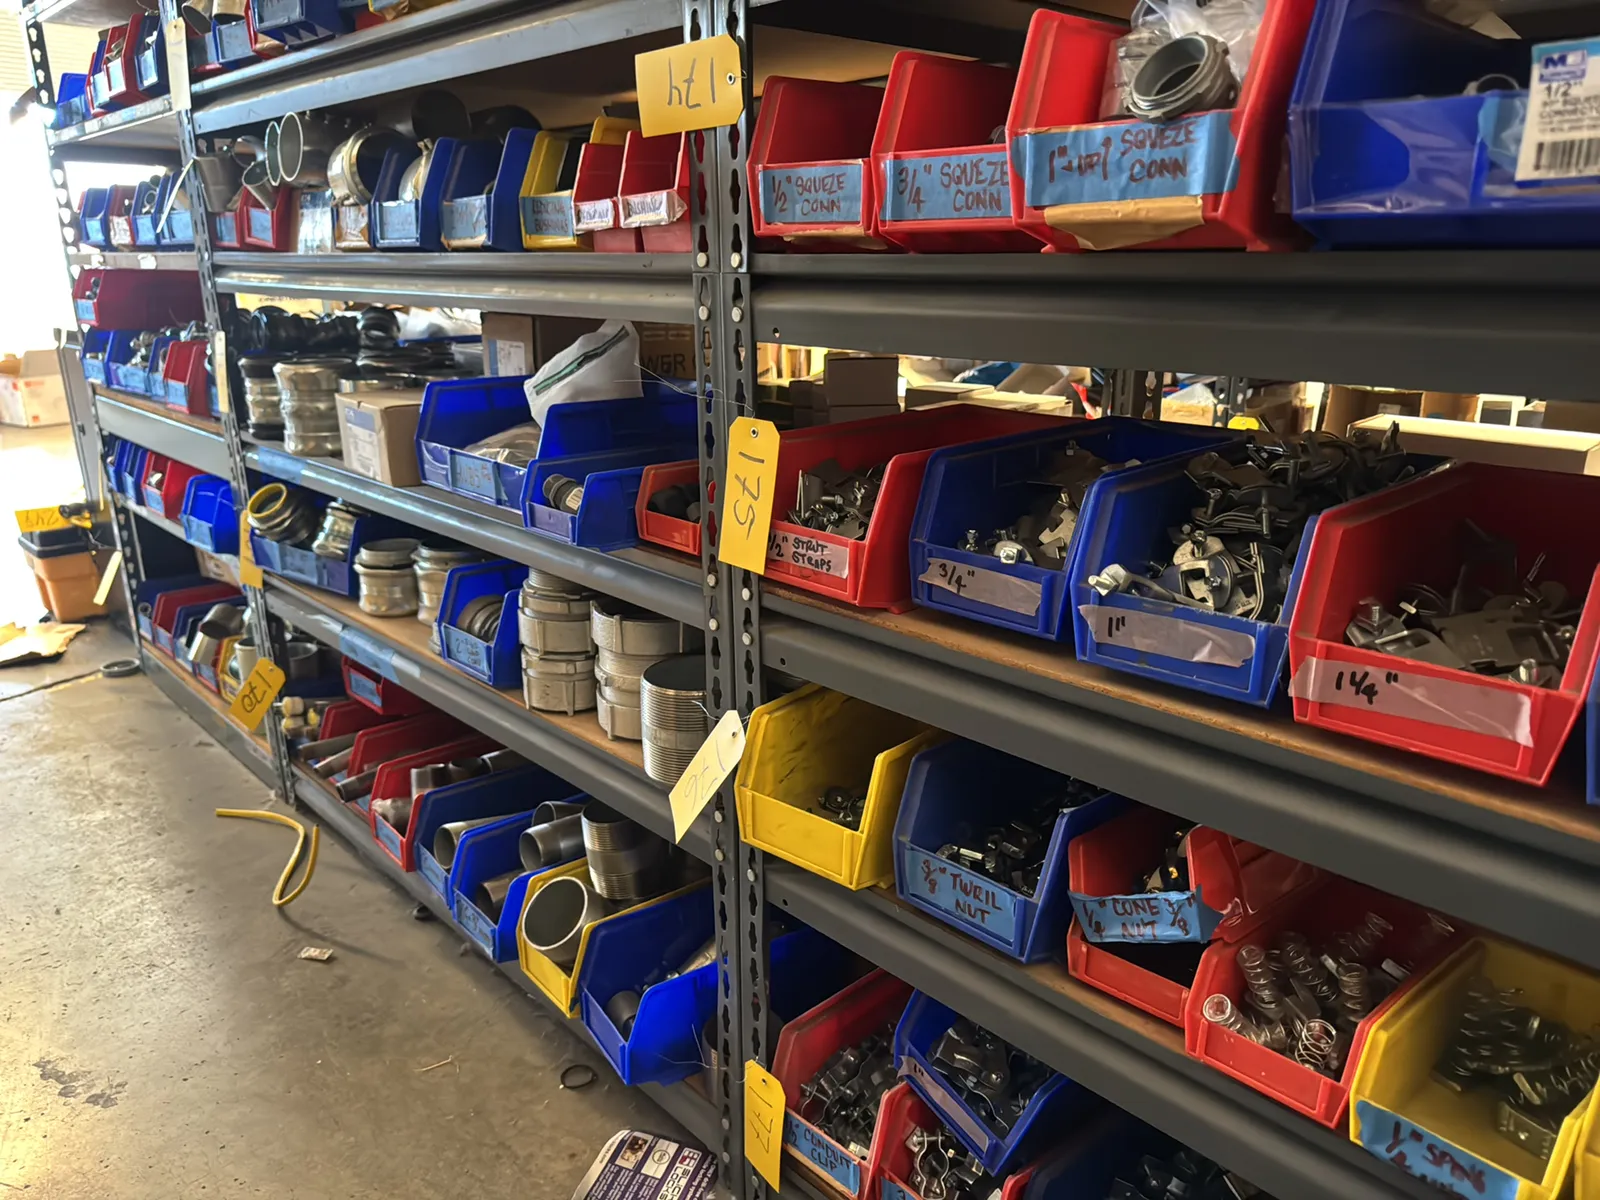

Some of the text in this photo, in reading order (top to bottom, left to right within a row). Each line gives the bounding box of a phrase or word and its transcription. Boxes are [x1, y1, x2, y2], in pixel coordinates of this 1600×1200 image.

[667, 56, 716, 109] 174
[1129, 156, 1187, 184] CONN
[772, 172, 847, 213] 1/2" SQUEZE
[897, 157, 1010, 213] 3/4" SQUEZE
[801, 198, 841, 216] CONN
[953, 189, 1003, 213] CONN
[734, 451, 765, 541] 175
[792, 536, 828, 556] STRUT
[792, 551, 832, 572] STRAPS
[939, 562, 975, 594] 3/4"
[1107, 616, 1126, 638] 1"
[241, 670, 272, 713] 170
[955, 899, 991, 924] NUT
[1111, 898, 1160, 916] CONE
[1121, 919, 1158, 940] NUT
[749, 1085, 774, 1154] 177
[811, 1147, 837, 1171] CLIP
